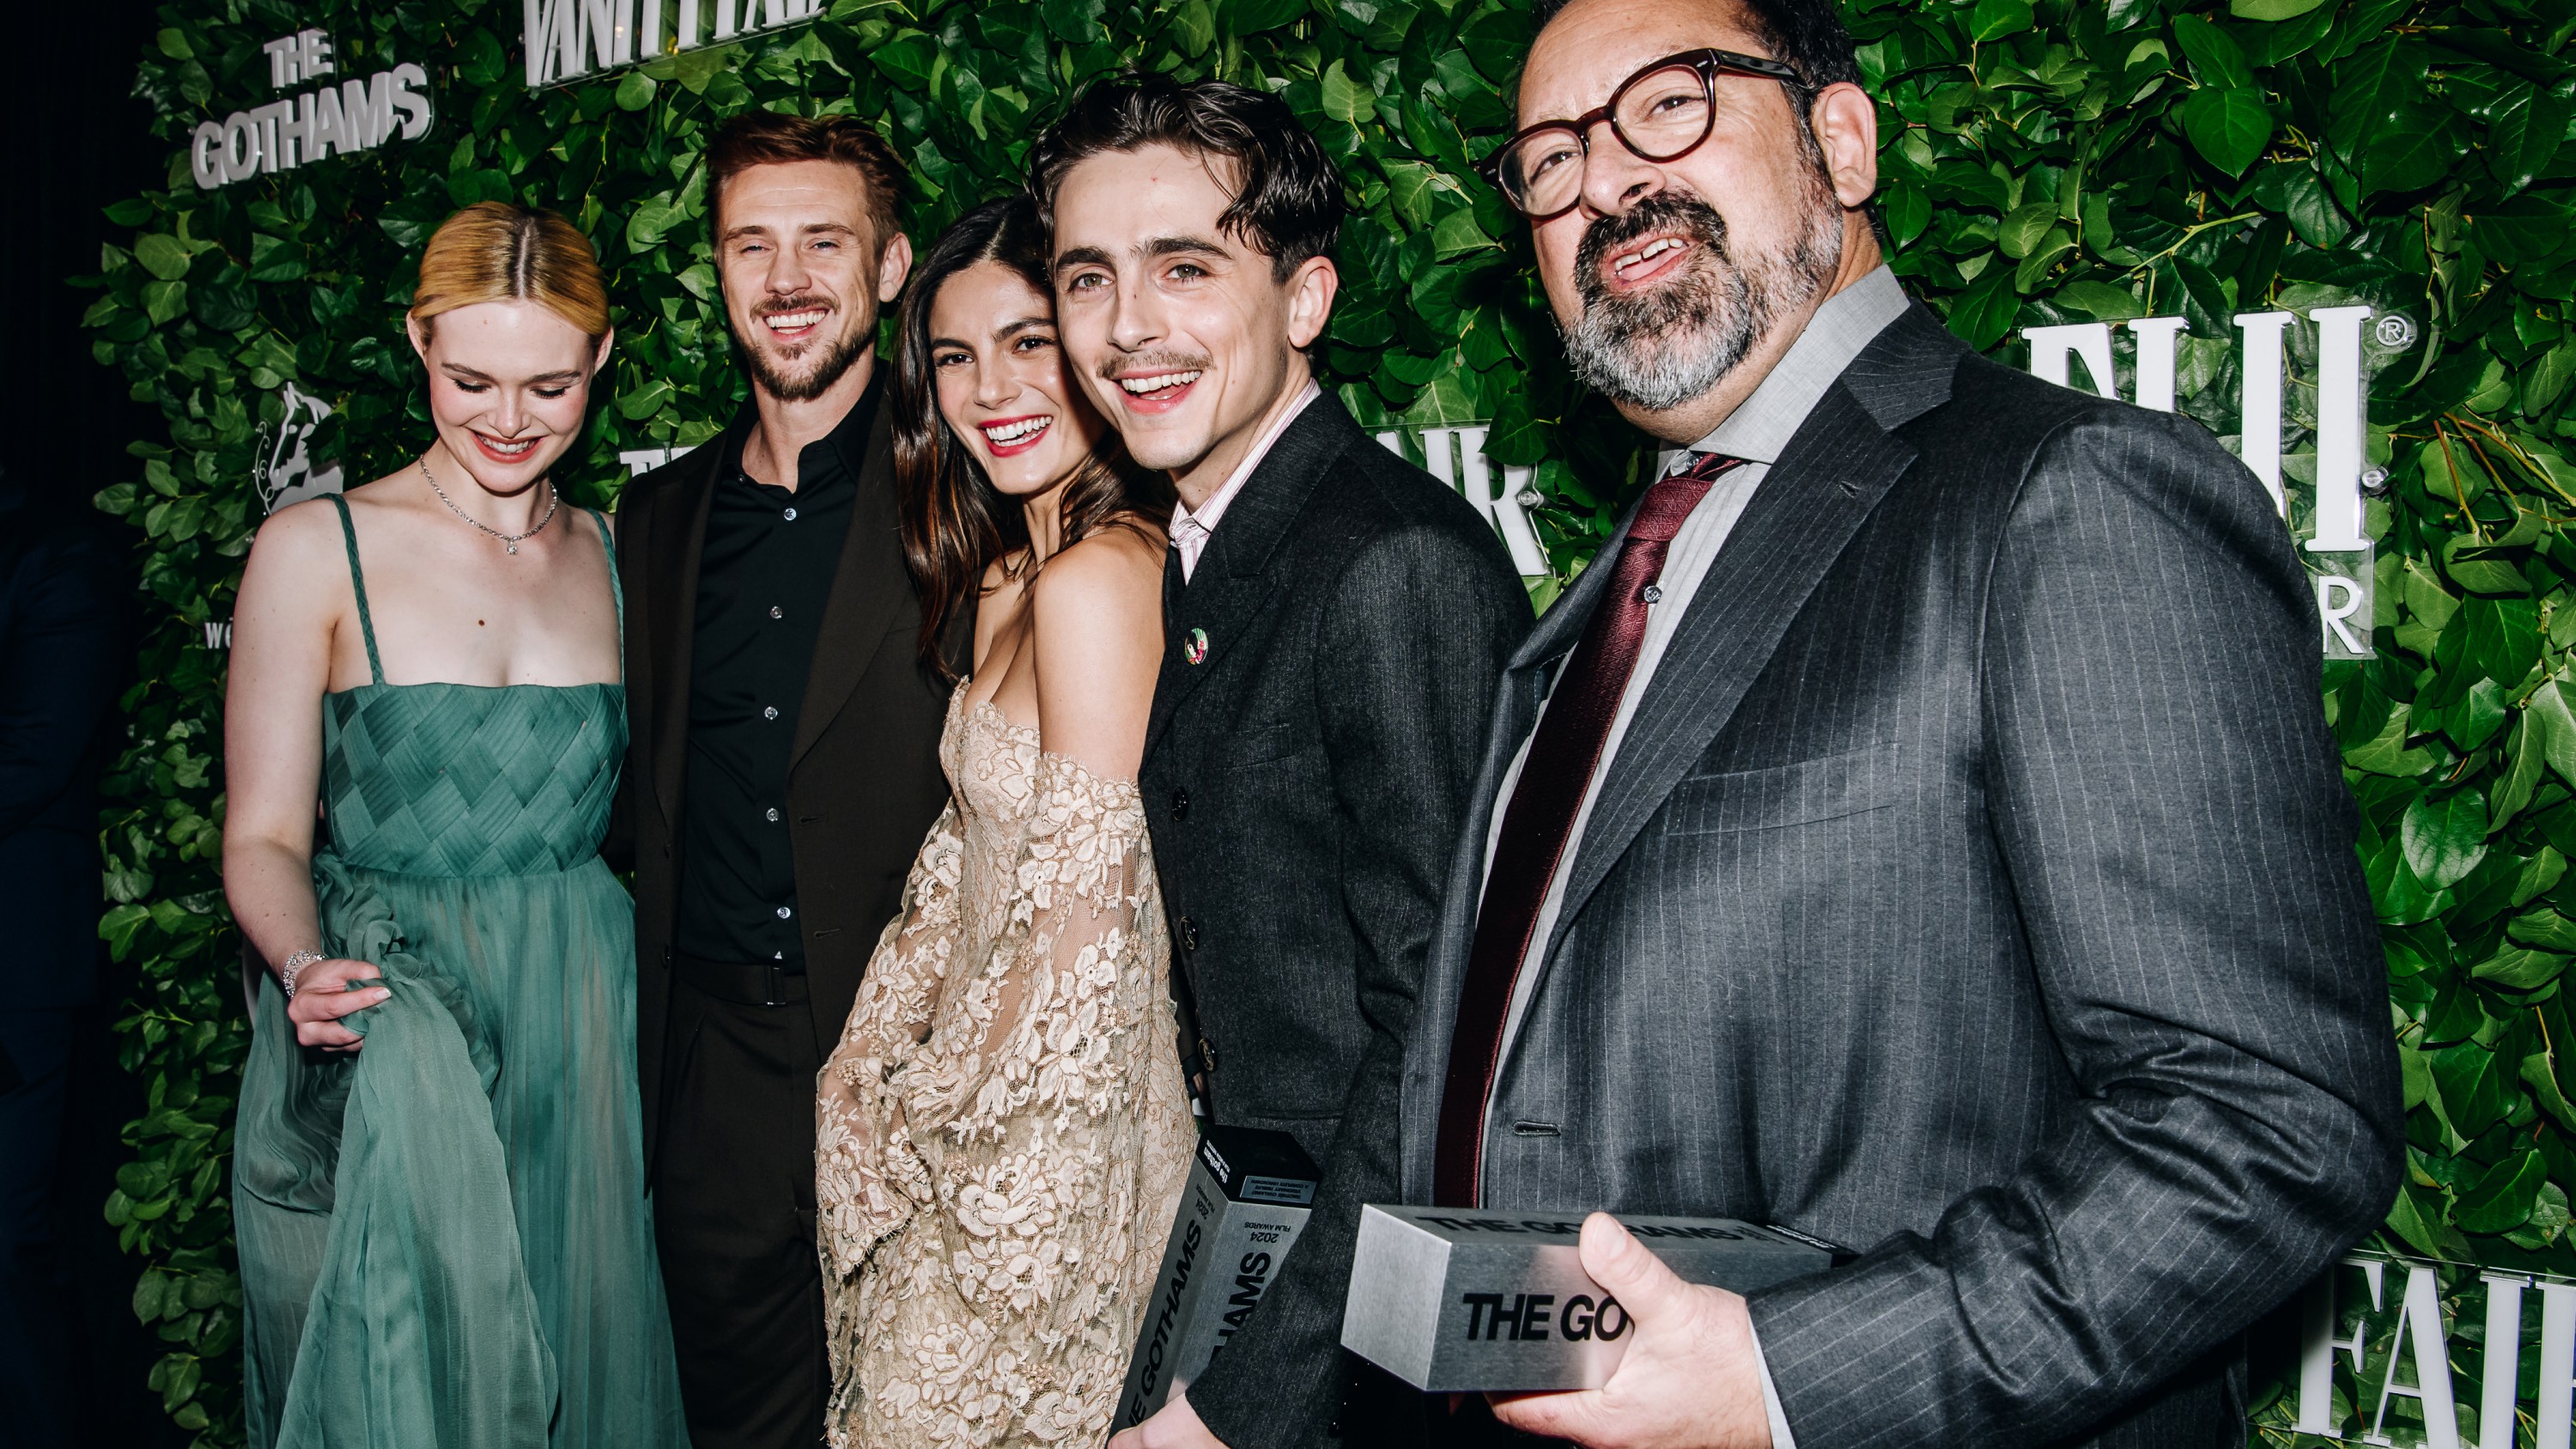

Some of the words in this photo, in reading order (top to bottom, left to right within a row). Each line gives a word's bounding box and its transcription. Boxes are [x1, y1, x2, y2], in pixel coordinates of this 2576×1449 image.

[264, 27, 333, 88] THE
[191, 63, 431, 190] GOTHAMS
[1244, 1221, 1275, 1231] AWARDS
[1250, 1231, 1279, 1243] 2024
[1415, 1216, 1529, 1233] THE
[1140, 1219, 1202, 1397] GOTHAMS
[1462, 1293, 1555, 1341] THE
